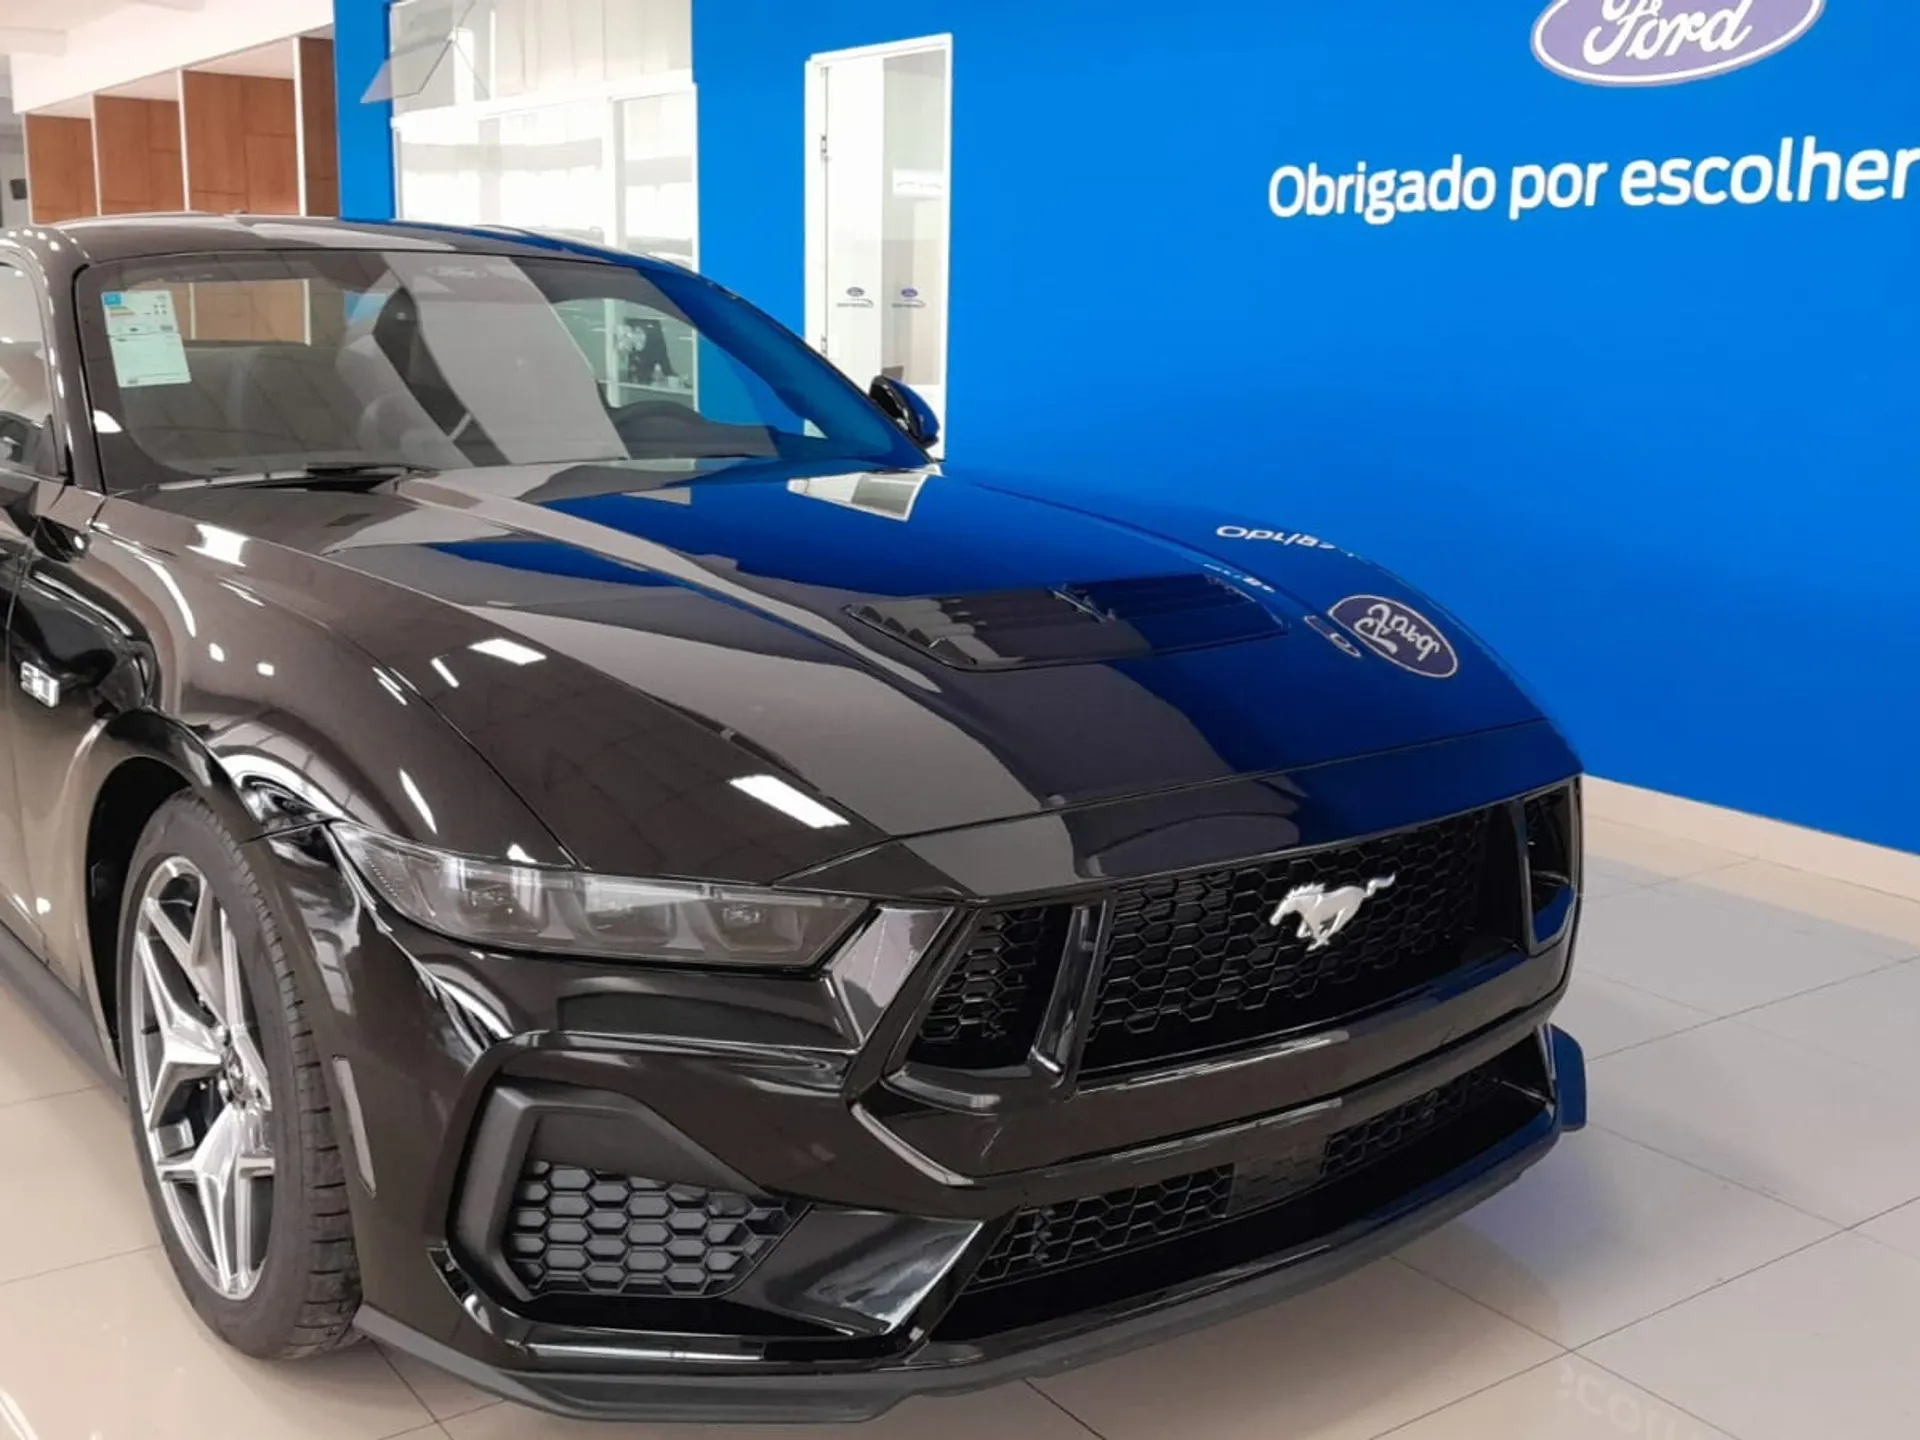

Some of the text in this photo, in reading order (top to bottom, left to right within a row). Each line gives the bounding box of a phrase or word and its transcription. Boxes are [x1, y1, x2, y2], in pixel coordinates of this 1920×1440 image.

[1582, 0, 1753, 66] Ford
[1268, 135, 1920, 226] Obrigado por escolher
